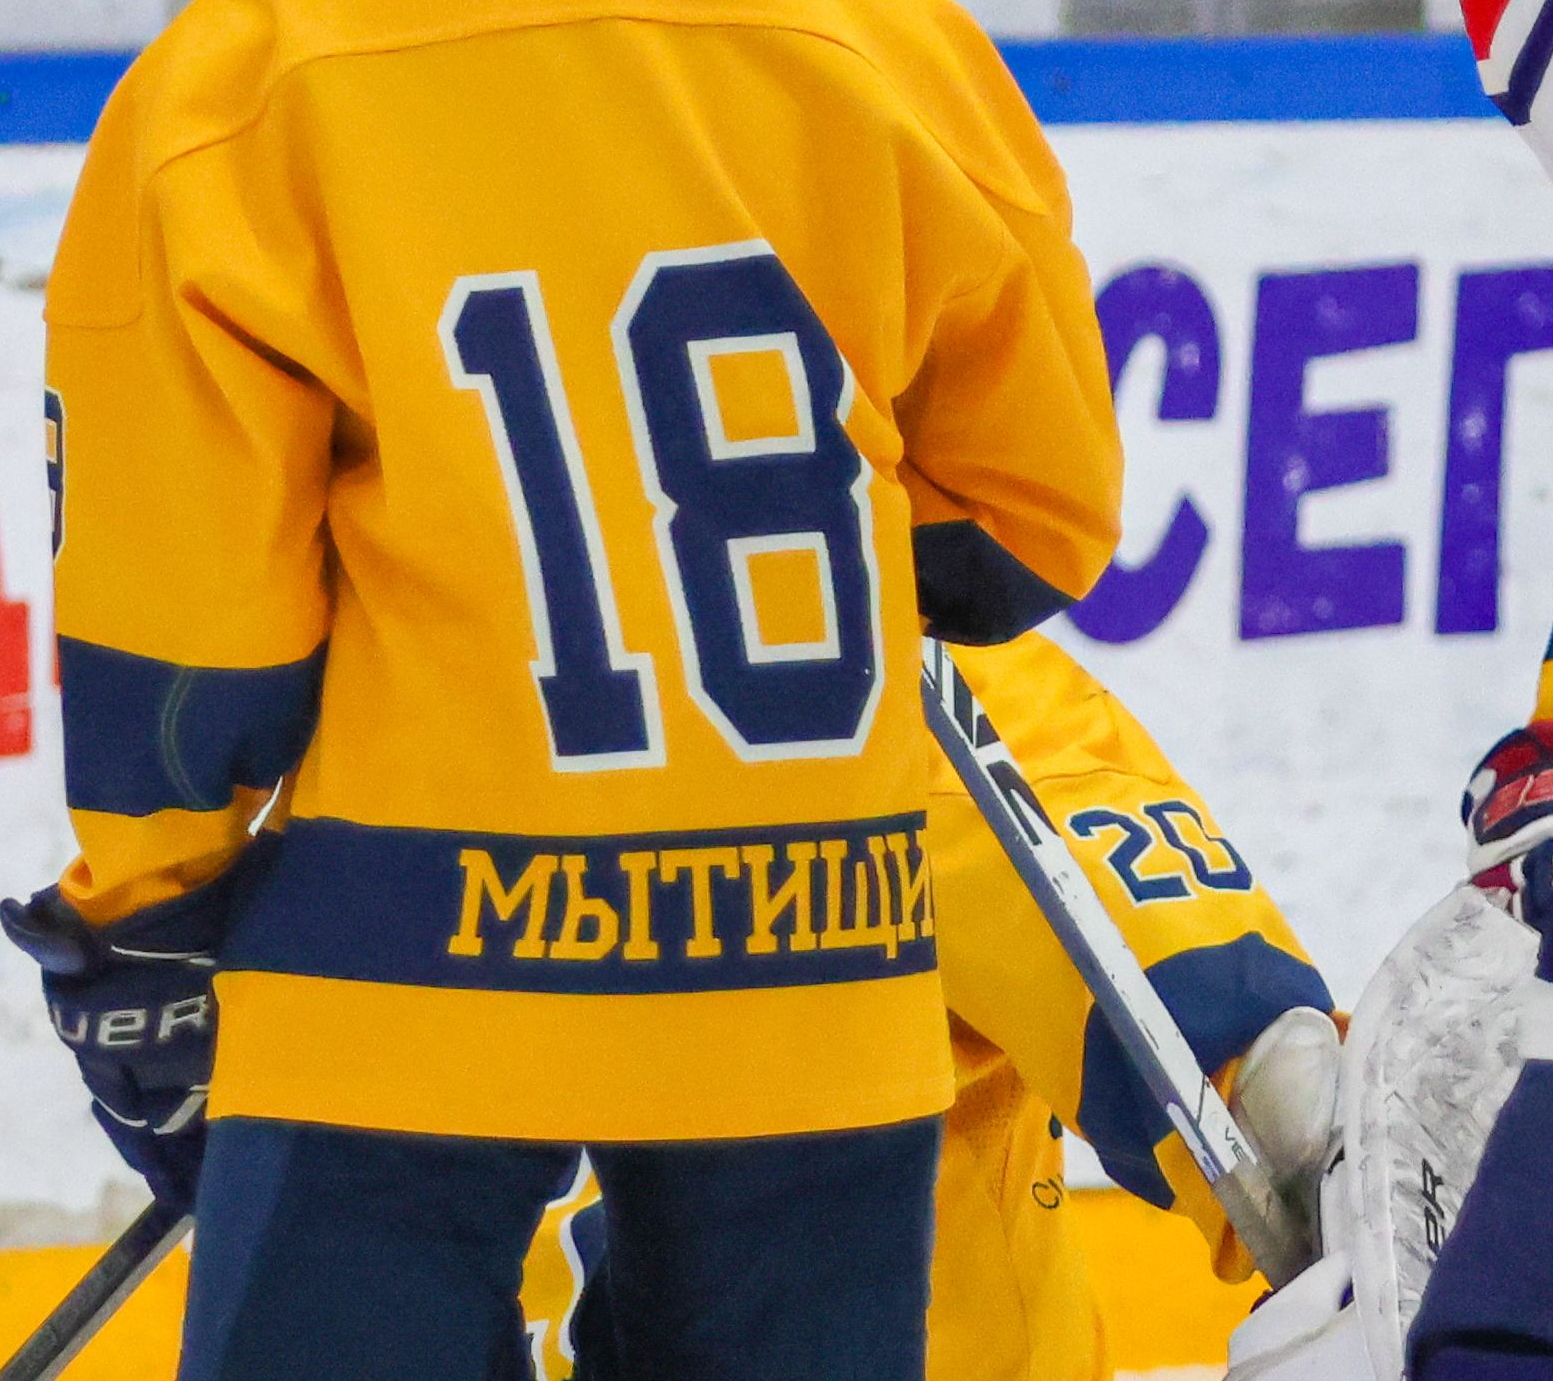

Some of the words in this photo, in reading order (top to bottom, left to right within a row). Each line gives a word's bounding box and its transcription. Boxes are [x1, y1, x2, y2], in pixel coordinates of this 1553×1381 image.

[438, 238, 889, 773] 18
[447, 836, 935, 969] МЫТИЩИ
[1063, 797, 1255, 908] 20
